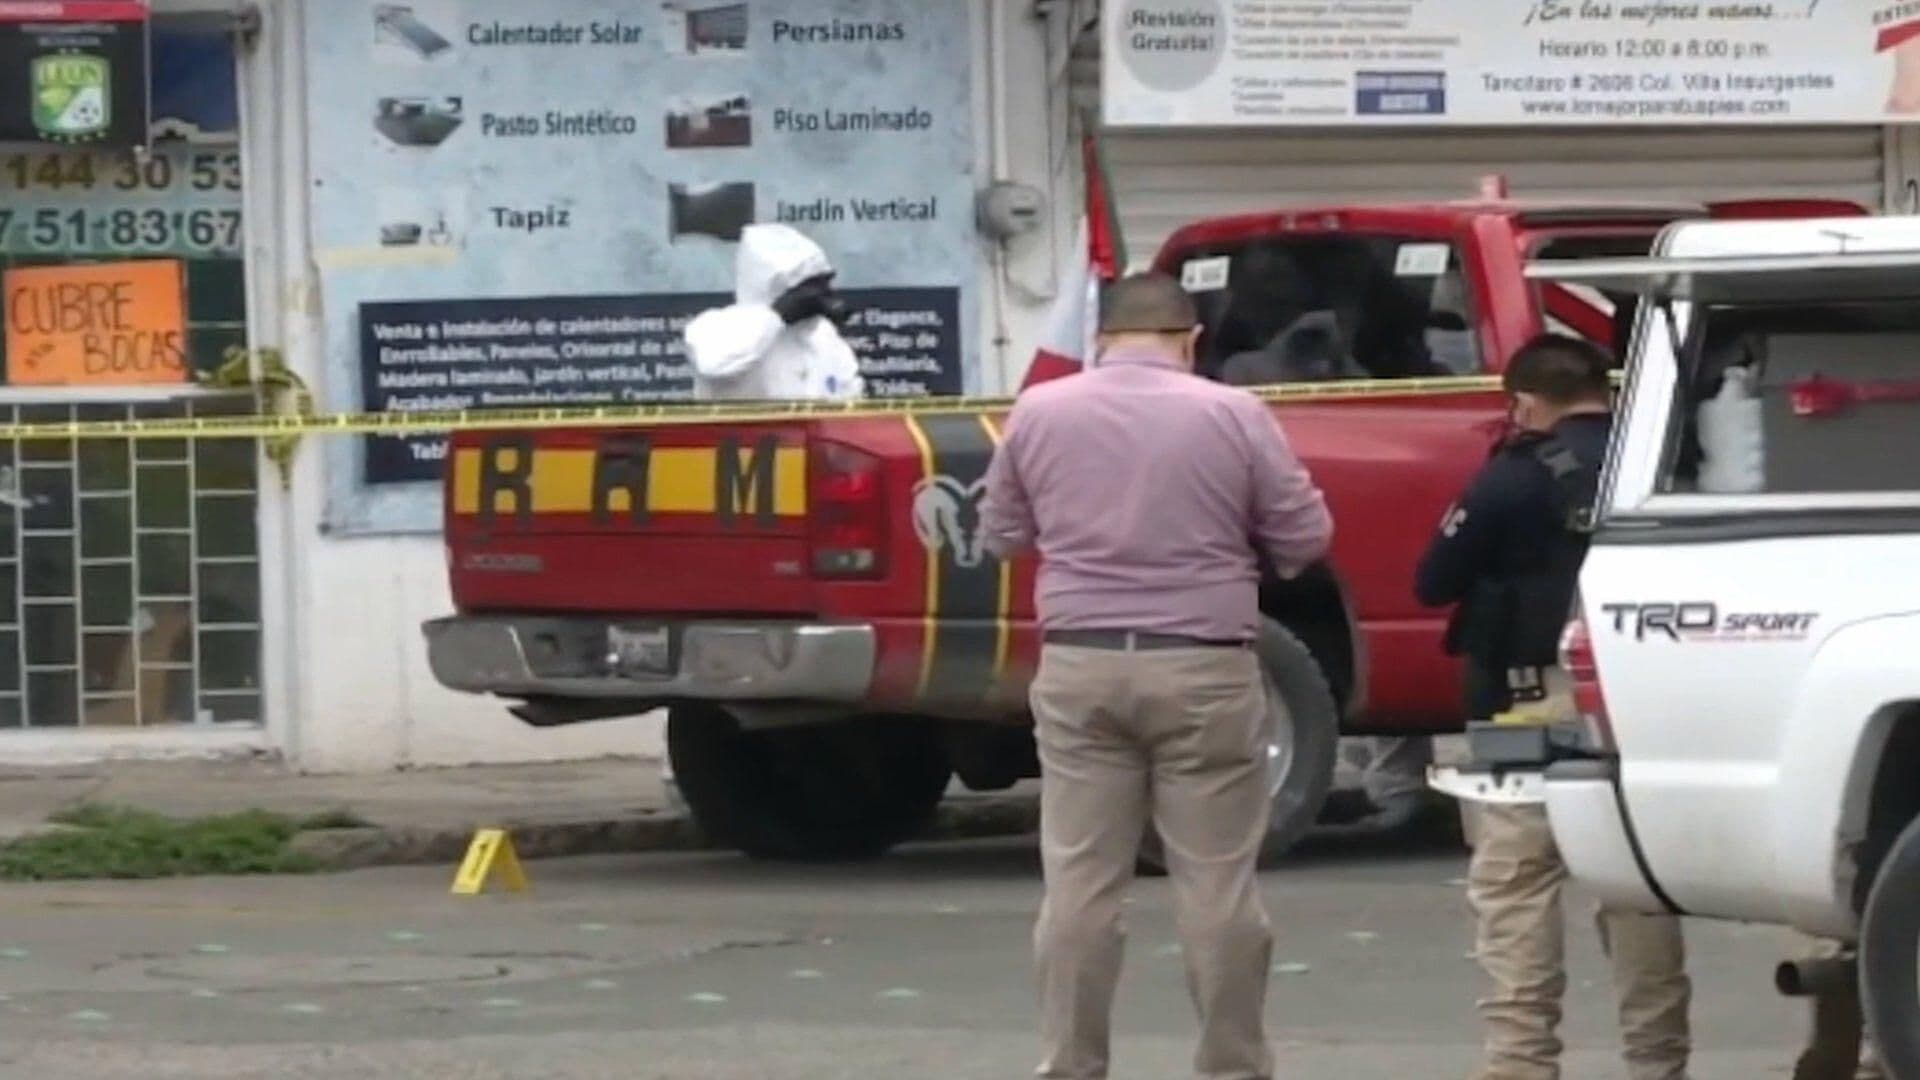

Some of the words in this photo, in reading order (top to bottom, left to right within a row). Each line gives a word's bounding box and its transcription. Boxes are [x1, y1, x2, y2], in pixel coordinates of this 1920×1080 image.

[467, 22, 584, 47] Calentador
[590, 21, 642, 45] Solar
[772, 19, 905, 43] Persianas
[1539, 40, 1608, 57] Horario
[1614, 40, 1666, 57] 12:00
[1671, 45, 1683, 57] a
[1638, 73, 1673, 91] Col.
[1682, 73, 1721, 91] Villa
[481, 112, 540, 136] Pasto
[545, 108, 637, 135] Sintético
[773, 108, 819, 132] Piso
[825, 106, 933, 132] Laminado
[6, 154, 96, 190] 144
[113, 154, 173, 190] 30
[490, 206, 571, 230] Tapiz
[850, 196, 937, 221] Vertical
[11, 281, 135, 336] CUBRE
[372, 323, 423, 340] Venta
[535, 318, 556, 336] de
[83, 330, 186, 376] BOCAS
[639, 340, 661, 356] de
[1723, 612, 1821, 632] SPORT
